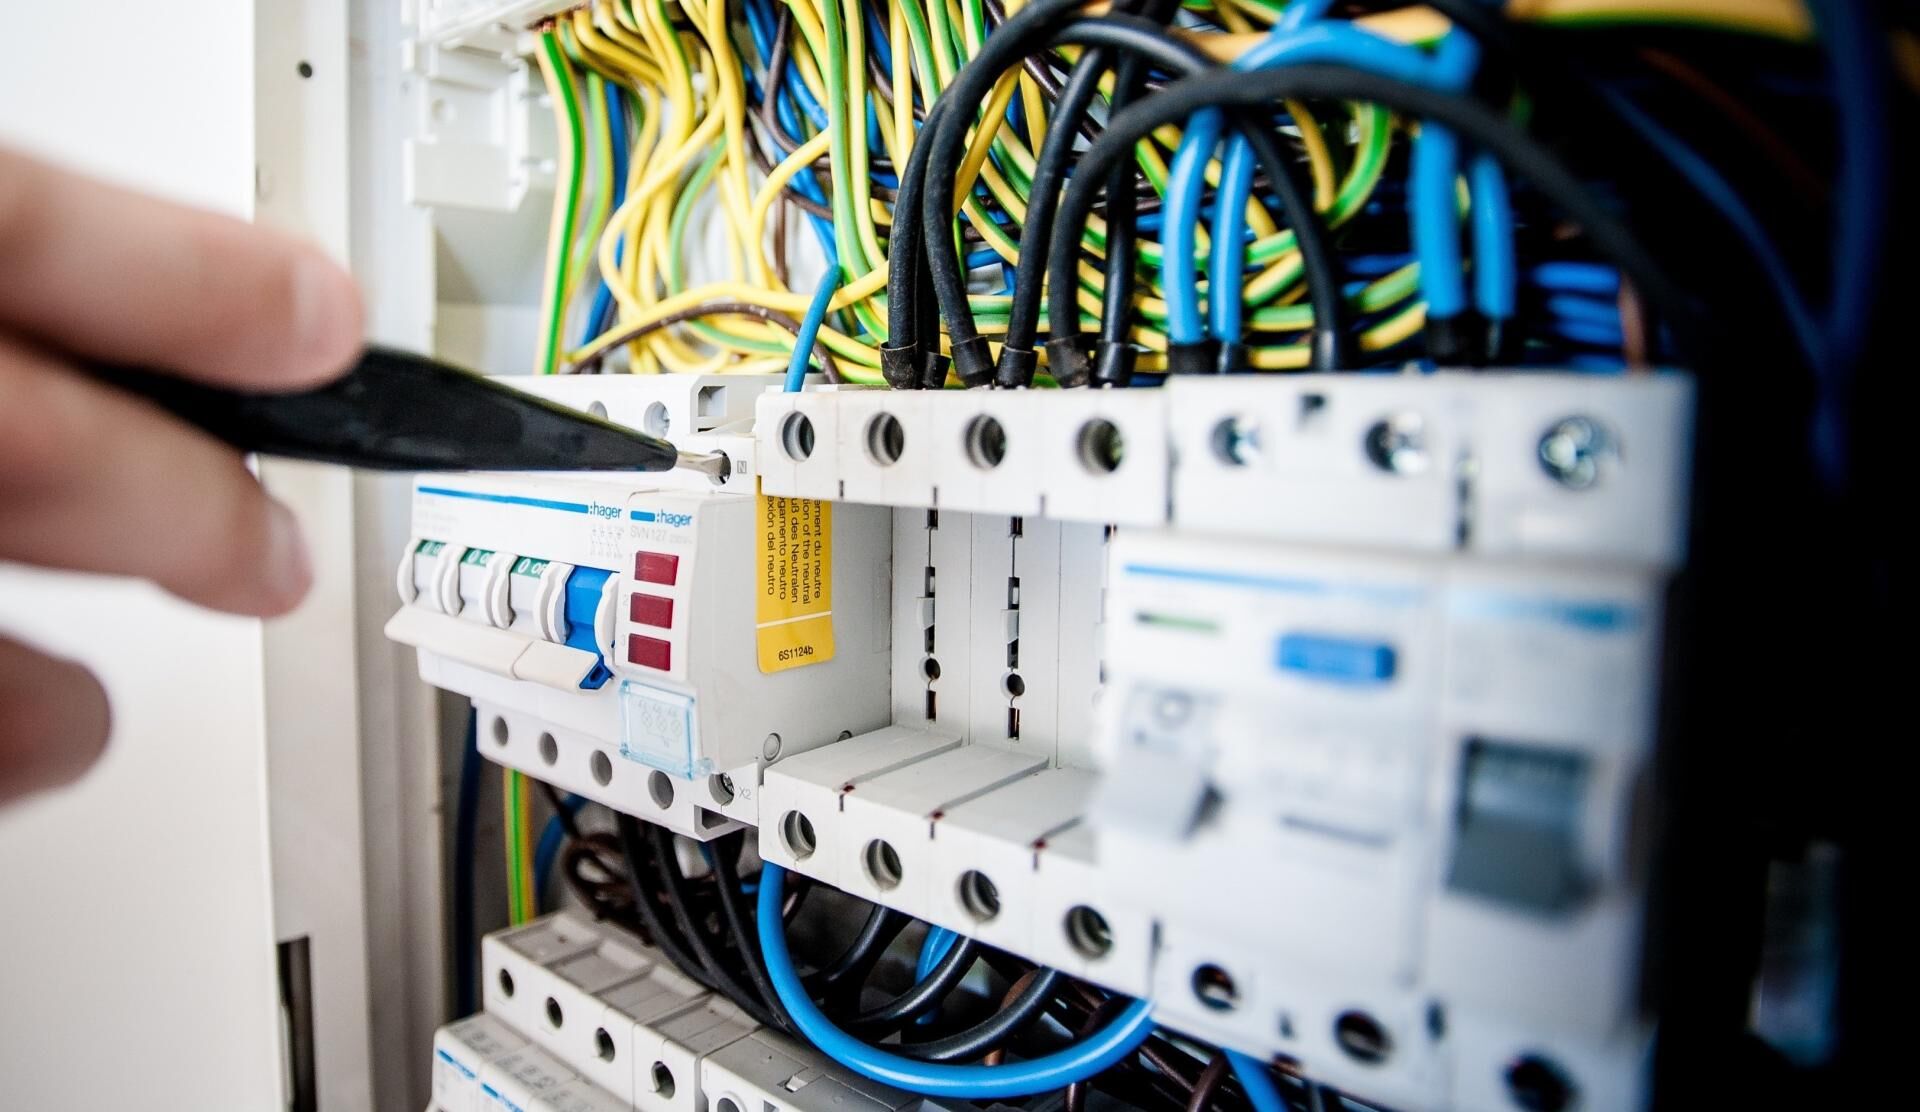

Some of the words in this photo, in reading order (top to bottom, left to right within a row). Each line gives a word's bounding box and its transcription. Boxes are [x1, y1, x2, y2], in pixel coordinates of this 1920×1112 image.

[791, 517, 799, 541] des
[803, 524, 811, 536] of
[767, 532, 776, 551] del
[803, 540, 811, 560] the
[814, 541, 822, 557] du
[767, 554, 776, 596] neutro
[779, 560, 787, 601] neutro
[791, 544, 799, 603] Neutralen
[803, 563, 811, 605] neutral
[778, 645, 814, 661] 6S1124b
[738, 786, 752, 801] X2
